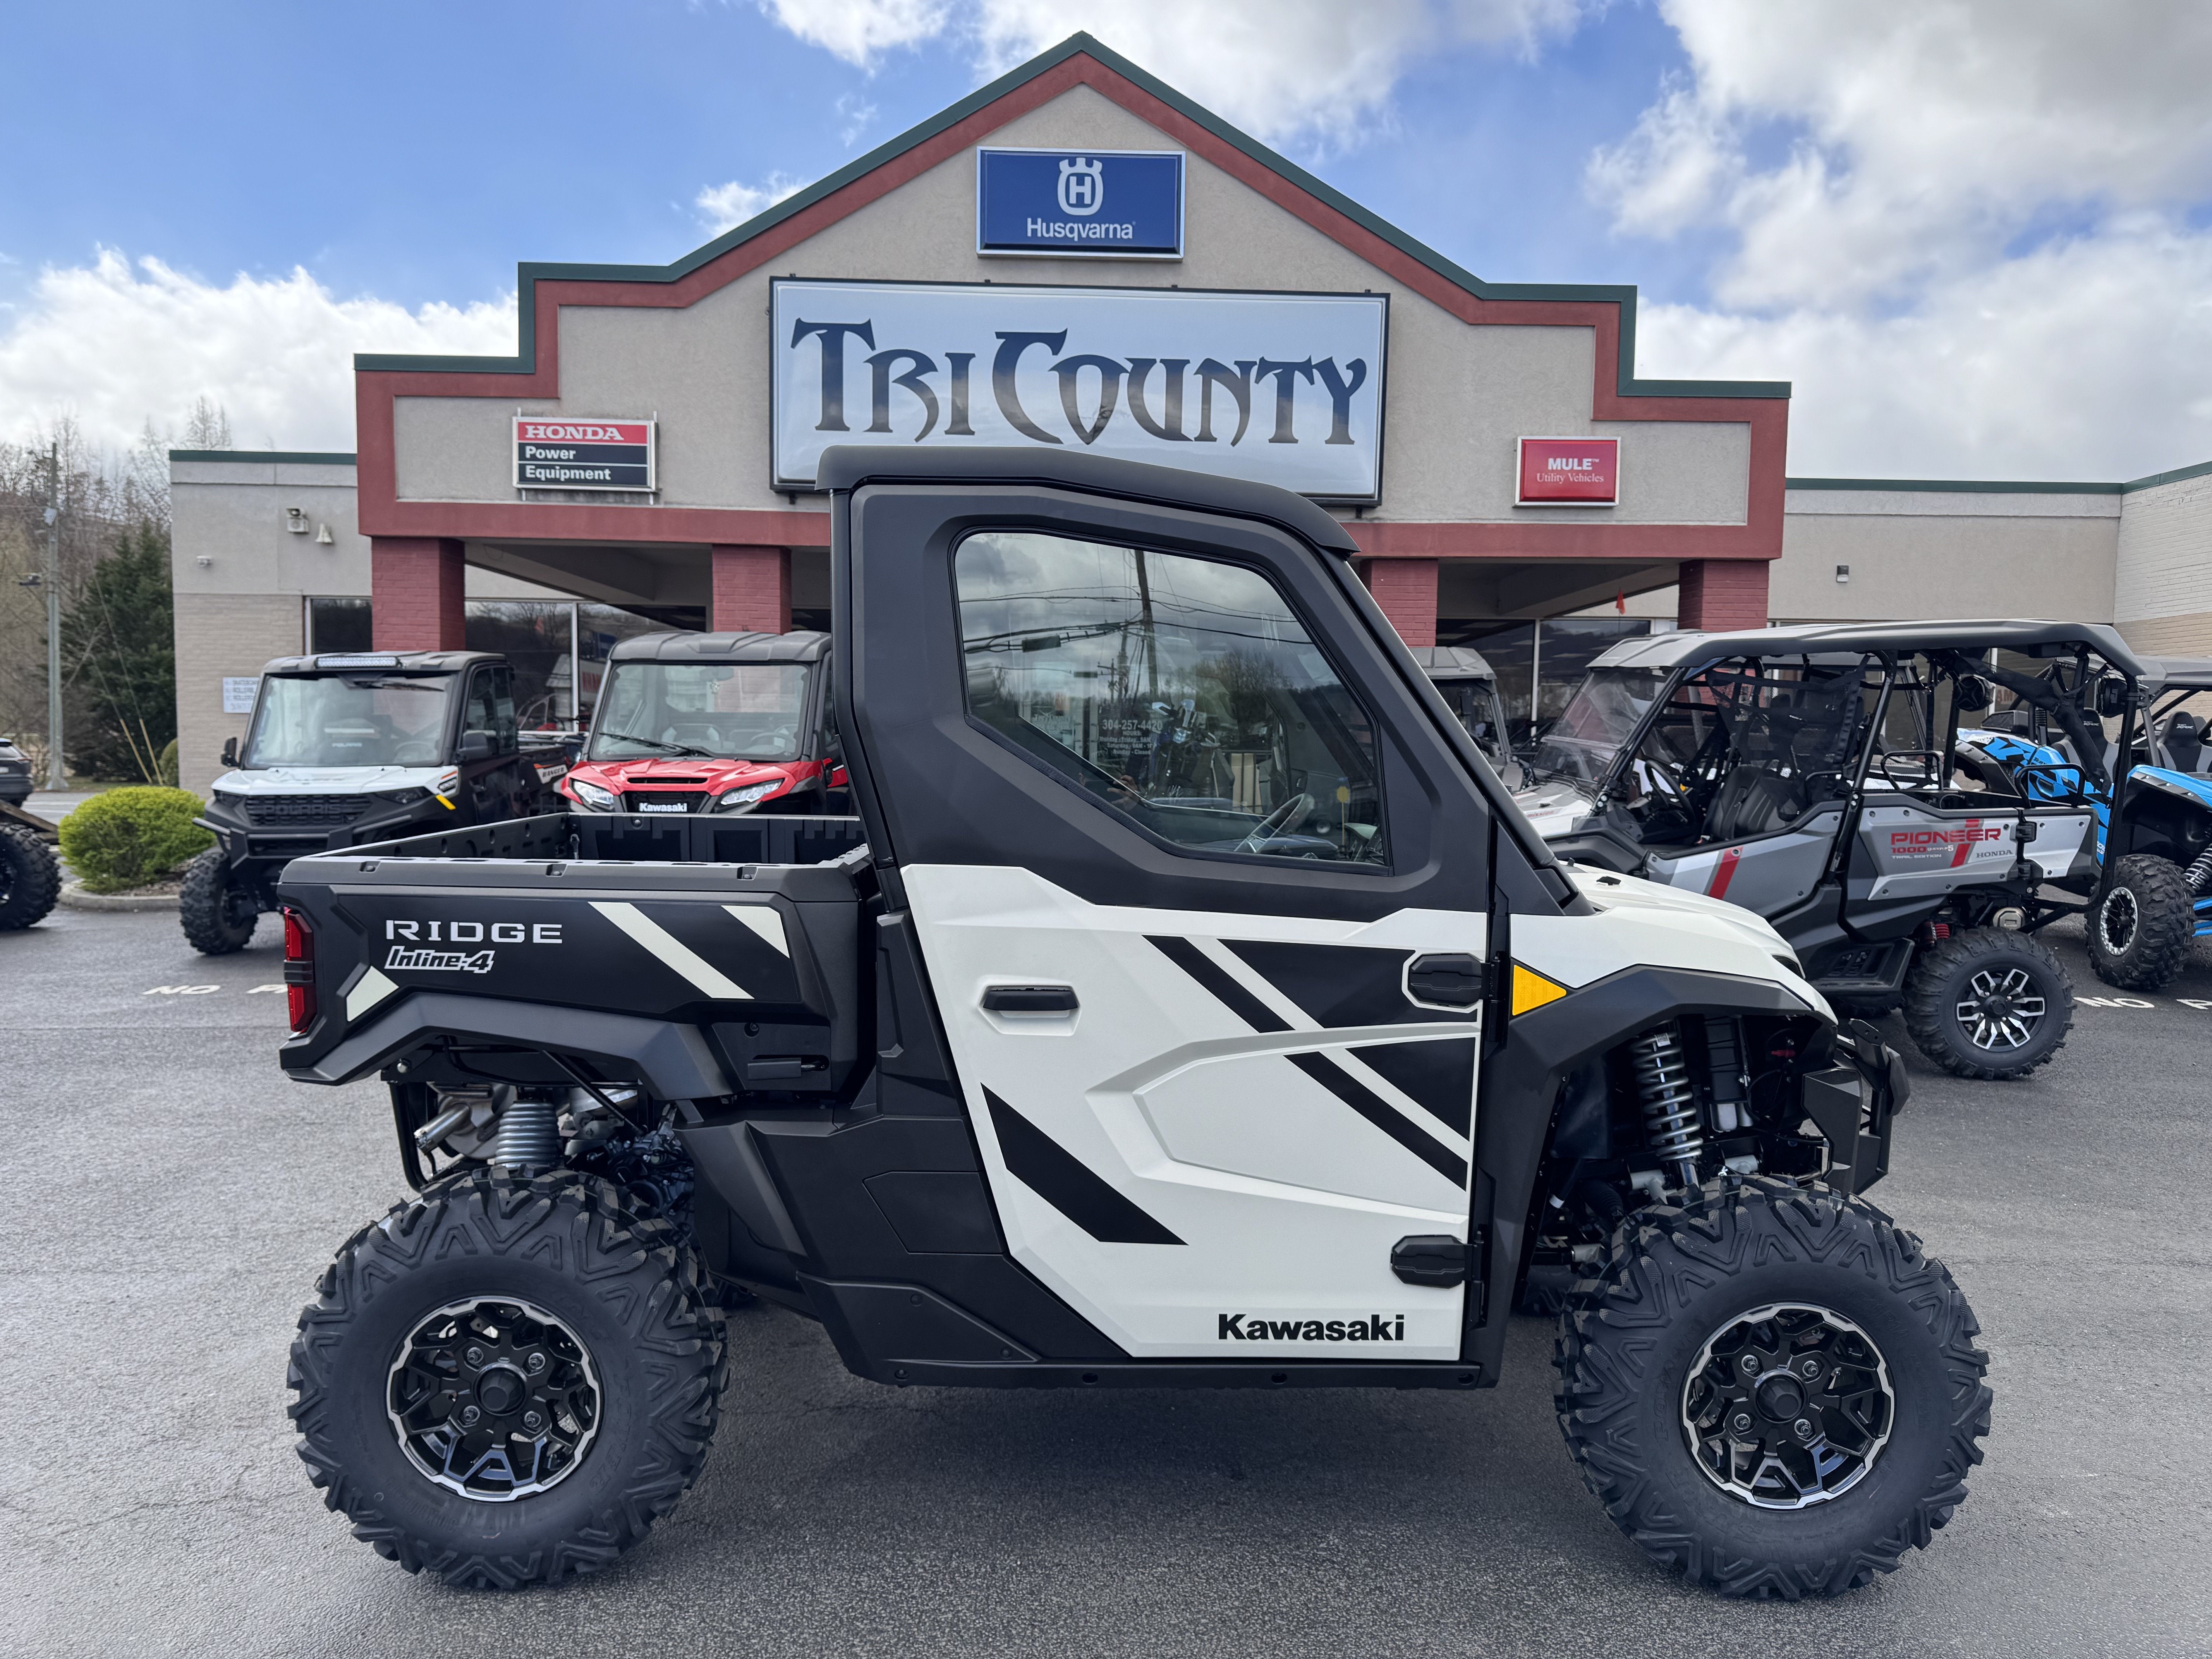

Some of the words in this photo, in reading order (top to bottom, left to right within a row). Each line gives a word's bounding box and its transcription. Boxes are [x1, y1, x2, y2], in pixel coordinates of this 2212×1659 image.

[1027, 218, 1133, 241] Husqvarna
[525, 425, 624, 441] HONDA
[525, 445, 576, 460] Power
[526, 465, 611, 481] Equipment
[1536, 473, 1565, 484] Utility
[1568, 473, 1604, 483] Vehicles
[1103, 719, 1162, 731] 304-257-4420
[639, 802, 687, 812] Kawasaki
[1891, 828, 2001, 845] PIONEER
[1976, 850, 2013, 858] HONDA
[386, 920, 563, 944] RIDGE
[384, 945, 495, 974] Inline-4
[142, 985, 221, 995] NO
[2073, 997, 2155, 1008] NO
[1218, 1314, 1405, 1341] Kawasaki
